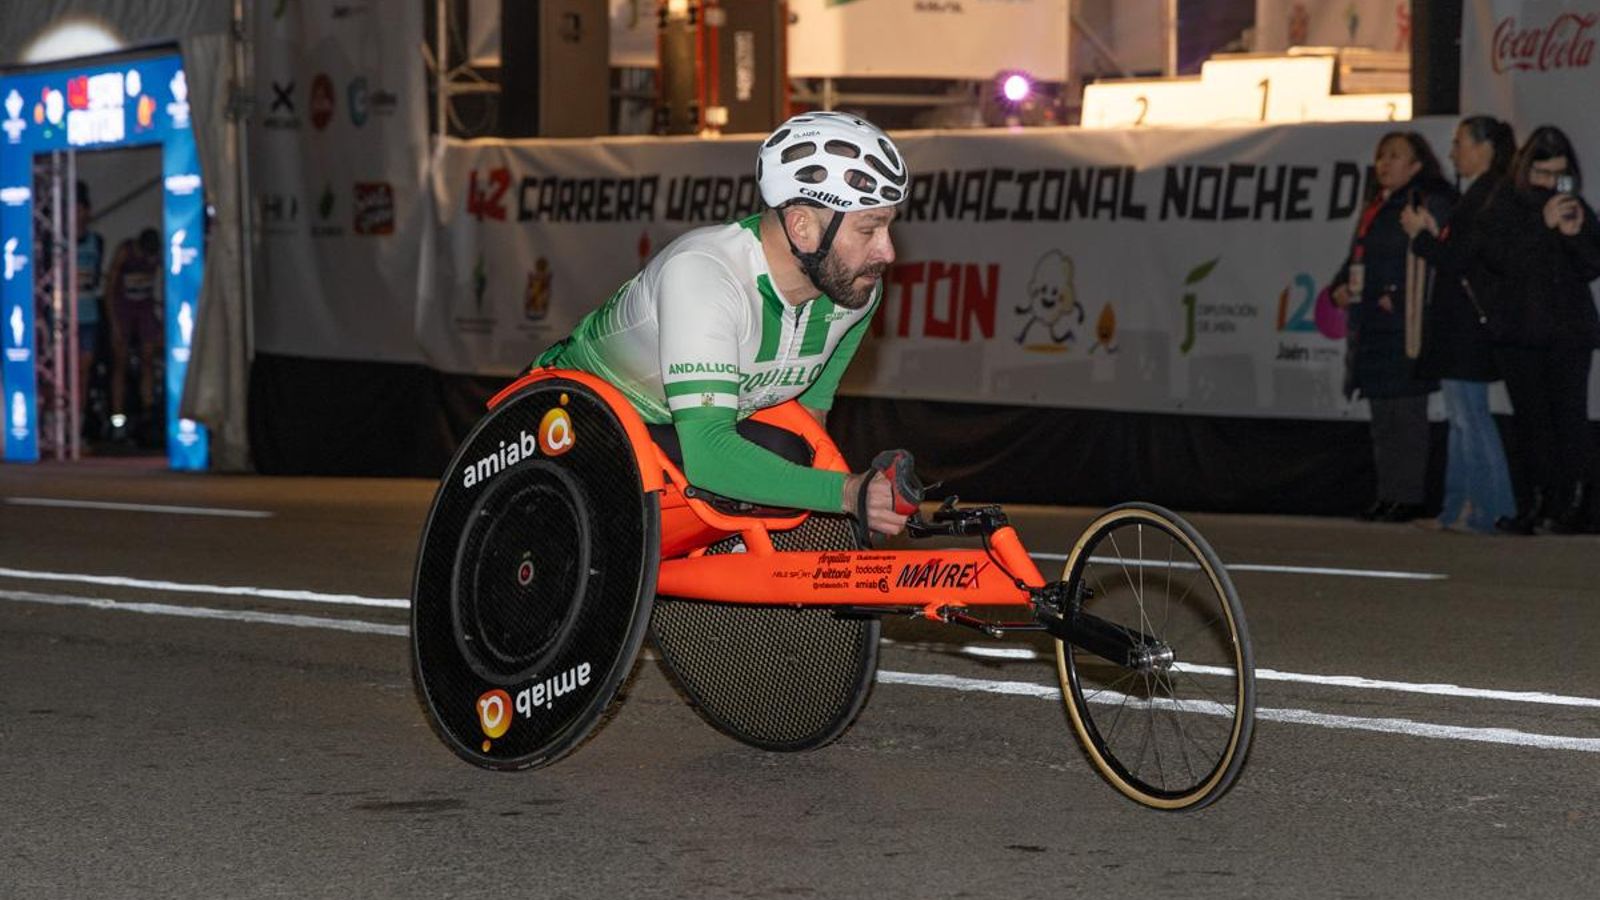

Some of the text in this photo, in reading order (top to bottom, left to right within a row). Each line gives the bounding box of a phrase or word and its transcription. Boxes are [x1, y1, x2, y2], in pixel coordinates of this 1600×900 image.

[1134, 96, 1148, 126] 2
[1258, 78, 1269, 121] 1
[466, 166, 512, 223] 42
[516, 174, 661, 223] CARRERA
[897, 166, 1146, 223] RNACIONAL
[1158, 162, 1319, 222] NOCHE
[799, 186, 853, 208] catlike
[463, 429, 536, 488] amiab
[855, 579, 878, 589] amiab
[896, 559, 990, 589] MAVREX
[516, 662, 592, 718] amiab
